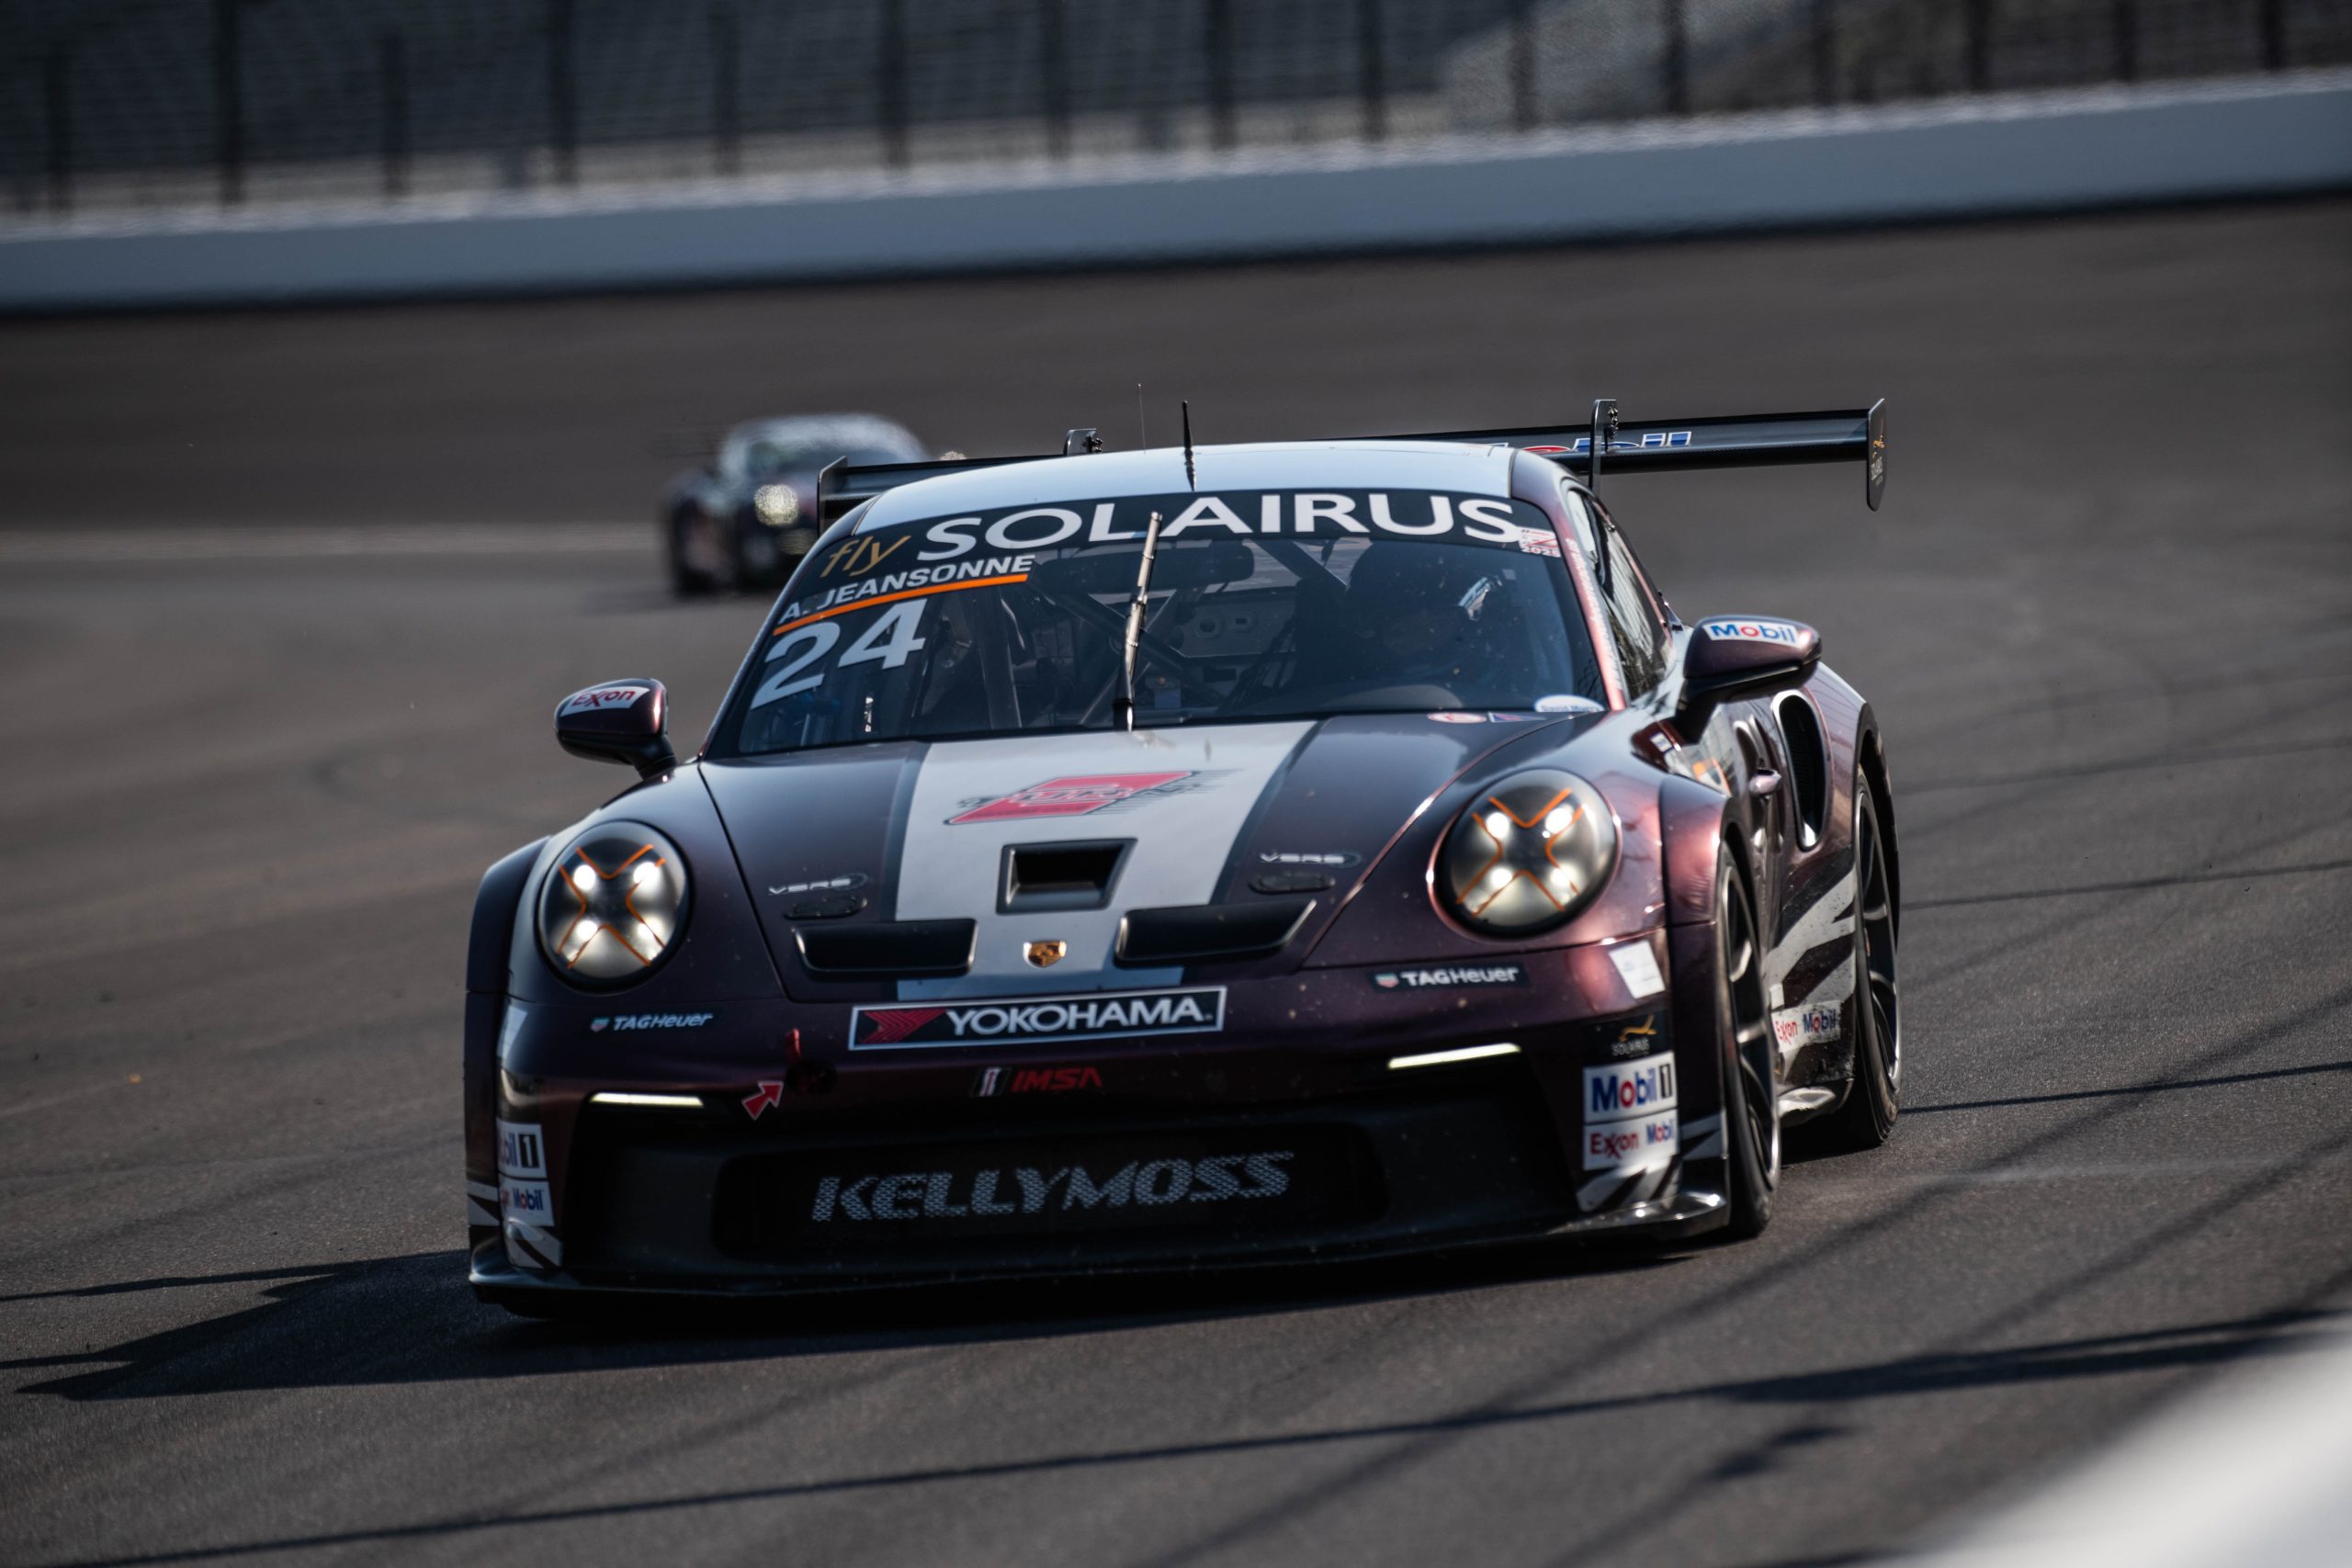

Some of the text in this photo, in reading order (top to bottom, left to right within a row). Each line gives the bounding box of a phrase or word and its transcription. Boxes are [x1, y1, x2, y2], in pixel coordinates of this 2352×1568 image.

[820, 493, 1521, 577] fly SOLAIRUS
[778, 555, 1035, 625] A. JEANSONNE
[1711, 625, 1796, 643] Mobil
[750, 598, 927, 711] 24
[571, 690, 636, 707] Exxon
[945, 998, 1204, 1036] YOKOHAMA
[1775, 1009, 1837, 1045] Exxon Mobil
[1012, 1066, 1103, 1092] IMSA
[1591, 1065, 1671, 1112] Mobil 1
[521, 1134, 536, 1168] 1
[1590, 1119, 1676, 1158] Exxon Mobil
[513, 1188, 544, 1211] Mobil
[812, 1151, 1295, 1221] KELLYMOSS
